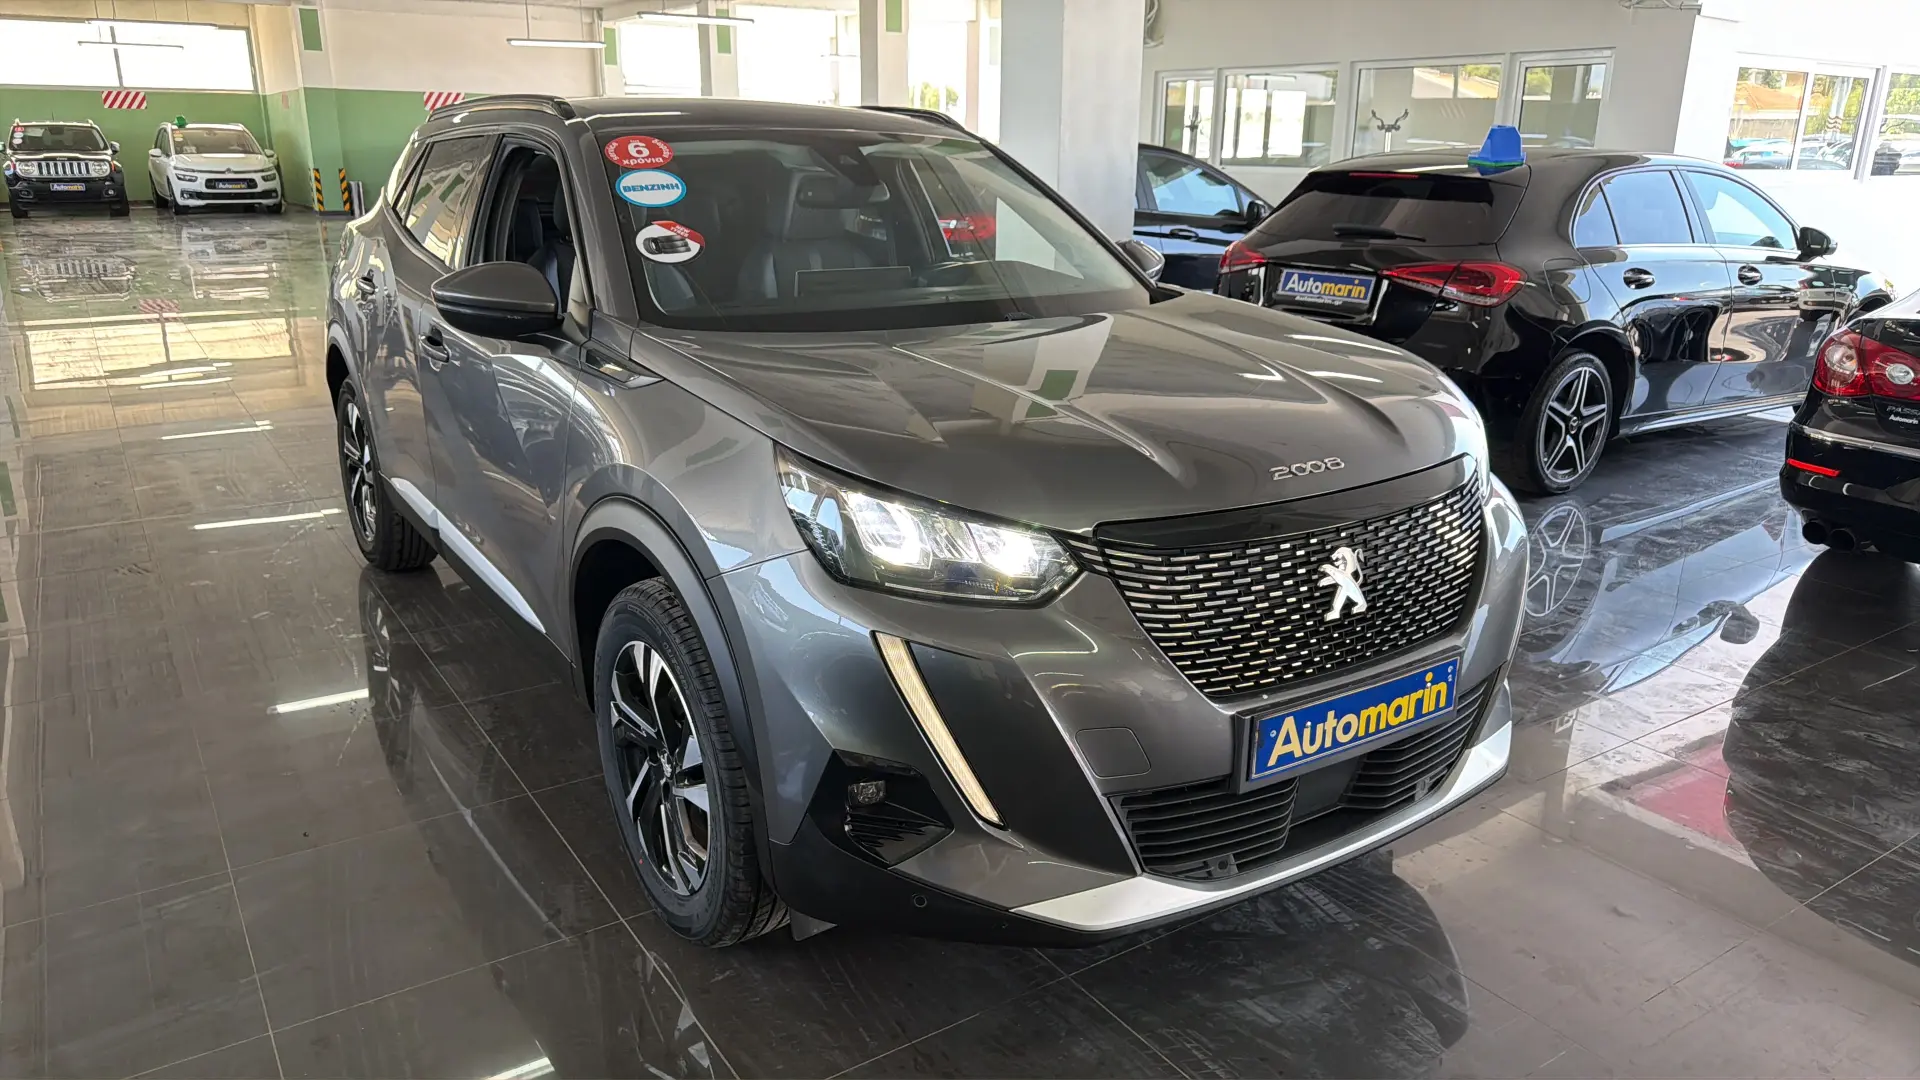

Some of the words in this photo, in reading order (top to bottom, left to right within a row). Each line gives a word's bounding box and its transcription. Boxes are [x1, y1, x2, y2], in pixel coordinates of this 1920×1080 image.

[627, 142, 650, 158] 6
[623, 157, 663, 166] χρόνια
[1285, 273, 1366, 299] Automarin
[1889, 414, 1919, 425] Automarin
[1269, 457, 1345, 481] 2008
[1267, 672, 1448, 767] Automarin
